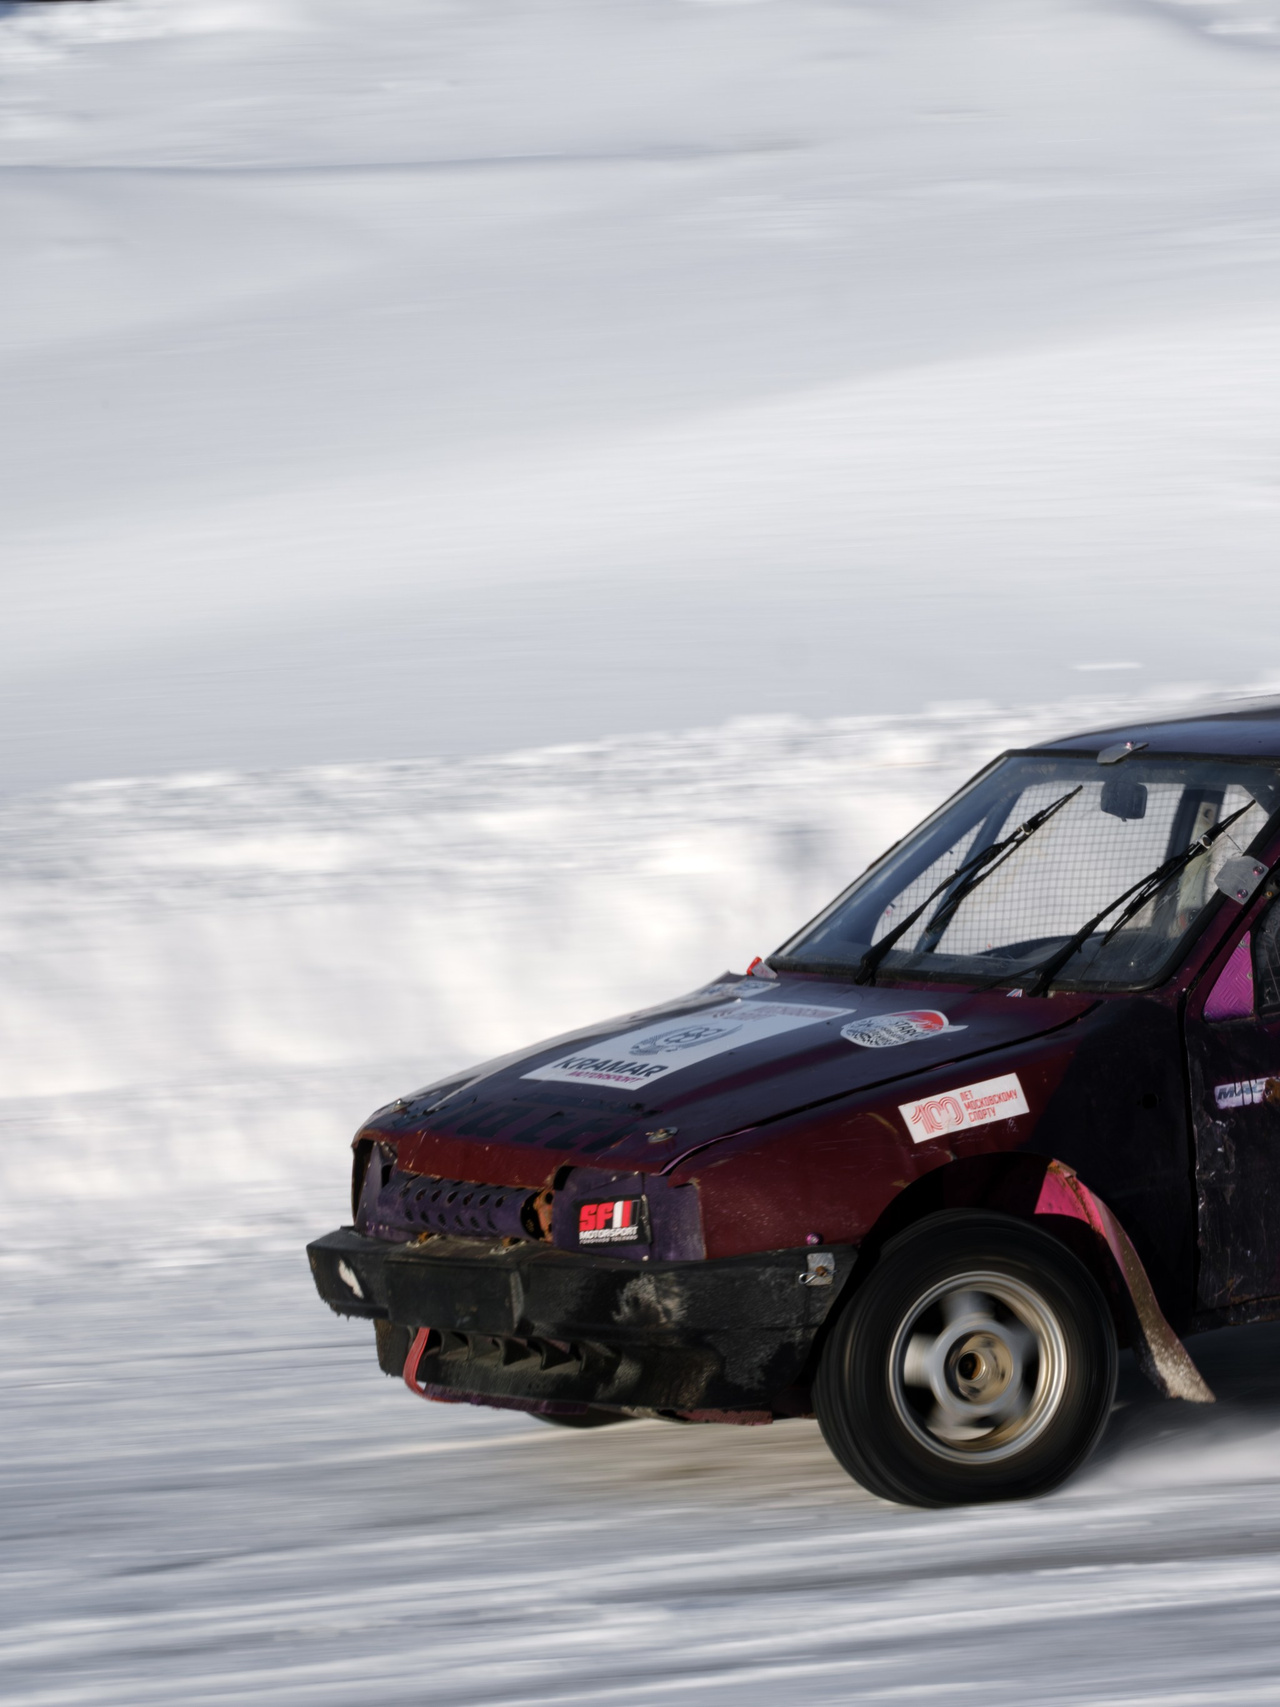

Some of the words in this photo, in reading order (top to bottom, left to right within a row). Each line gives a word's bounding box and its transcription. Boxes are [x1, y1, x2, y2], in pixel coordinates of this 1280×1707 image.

[551, 1056, 669, 1078] KRAMAR
[963, 1089, 1018, 1111] МОСКОВСКОМУ
[911, 1096, 964, 1134] 100
[968, 1107, 996, 1122] СПОРТУ
[579, 1226, 638, 1240] MOTORSPORT
